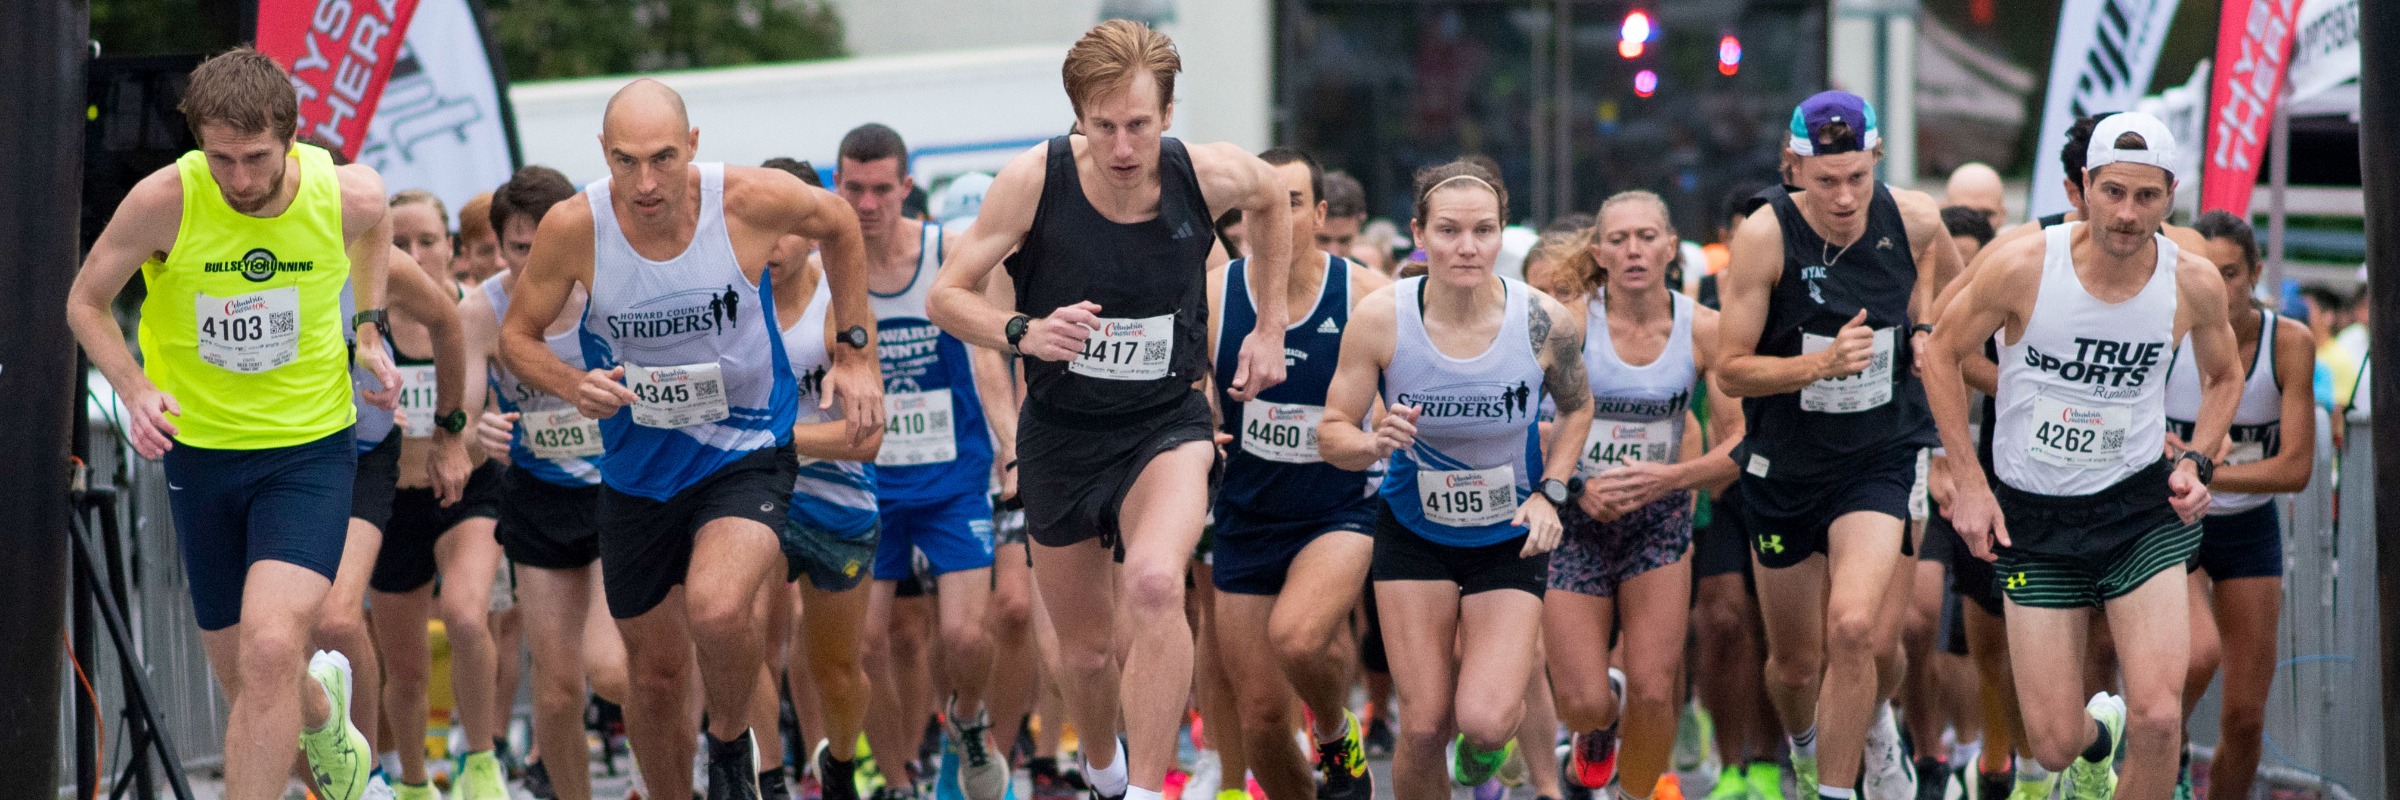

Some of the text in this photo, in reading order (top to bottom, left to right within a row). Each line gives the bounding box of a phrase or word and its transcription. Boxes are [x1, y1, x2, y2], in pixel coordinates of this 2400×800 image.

[1801, 266, 1827, 280] NYAC
[620, 306, 707, 320] HOWARD COUNTY
[203, 316, 263, 342] 4103
[607, 312, 713, 339] STRIDERS
[878, 326, 940, 343] WARD
[2074, 337, 2165, 366] TRUE
[2025, 345, 2149, 387] SPORTS
[399, 387, 434, 409] 411
[634, 382, 689, 403] 4345
[1412, 393, 1499, 403] HOWARD COUNTY
[2093, 385, 2141, 399] Running
[884, 412, 925, 435] 410
[1247, 419, 1300, 448] 4460
[535, 426, 584, 447] 4329
[2036, 421, 2096, 453] 4262
[1426, 490, 1483, 513] 4195
